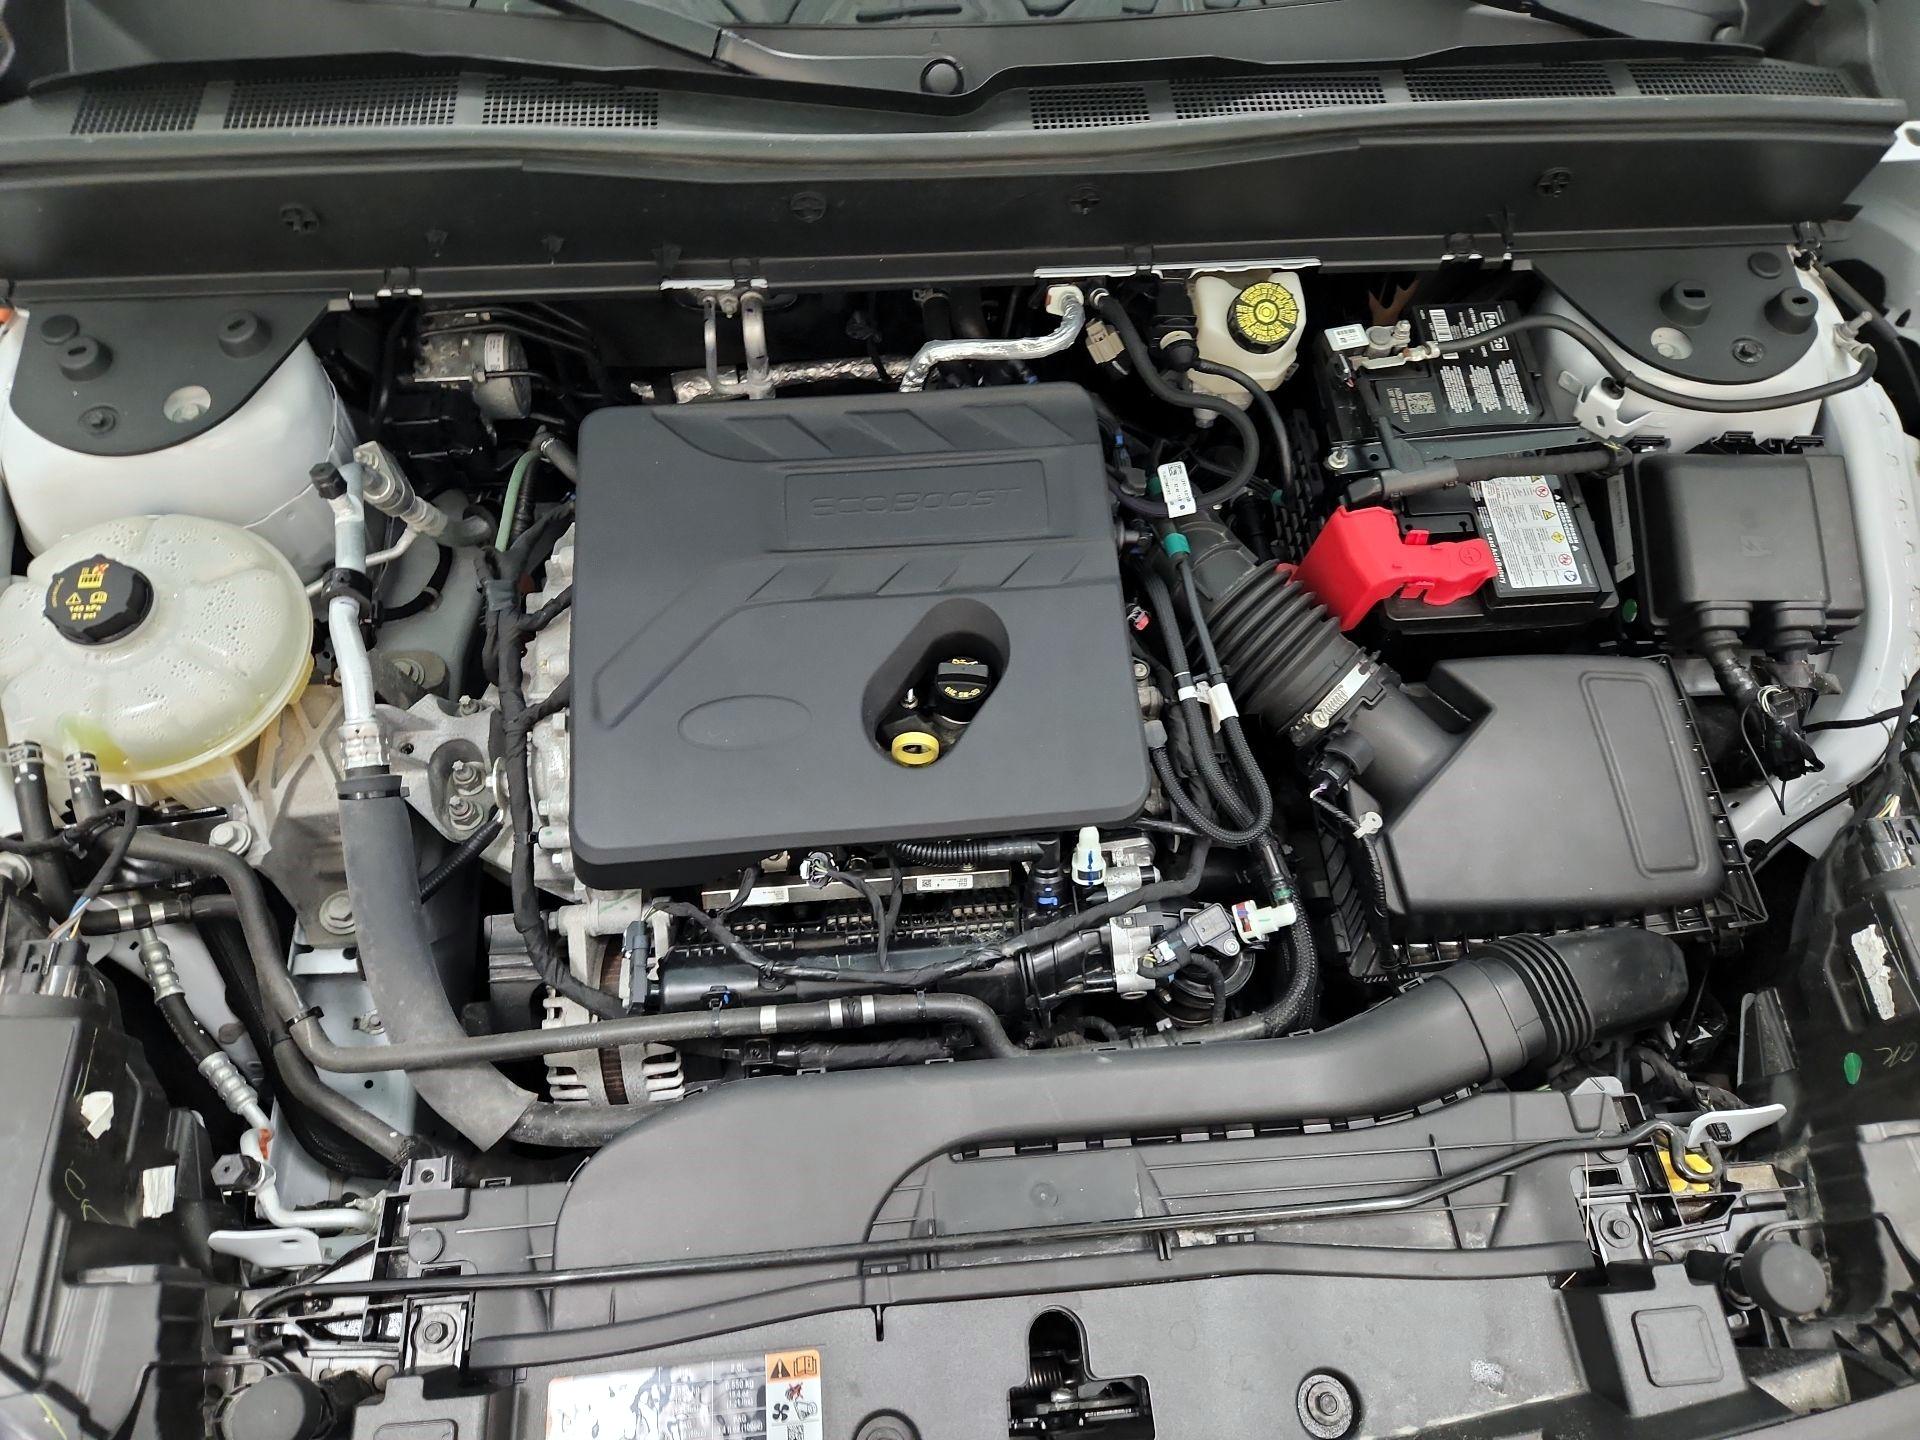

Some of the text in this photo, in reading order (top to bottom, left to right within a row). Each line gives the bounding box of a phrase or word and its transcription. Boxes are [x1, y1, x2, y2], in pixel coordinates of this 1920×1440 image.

[1486, 533, 1507, 584] Lead Acid Battery
